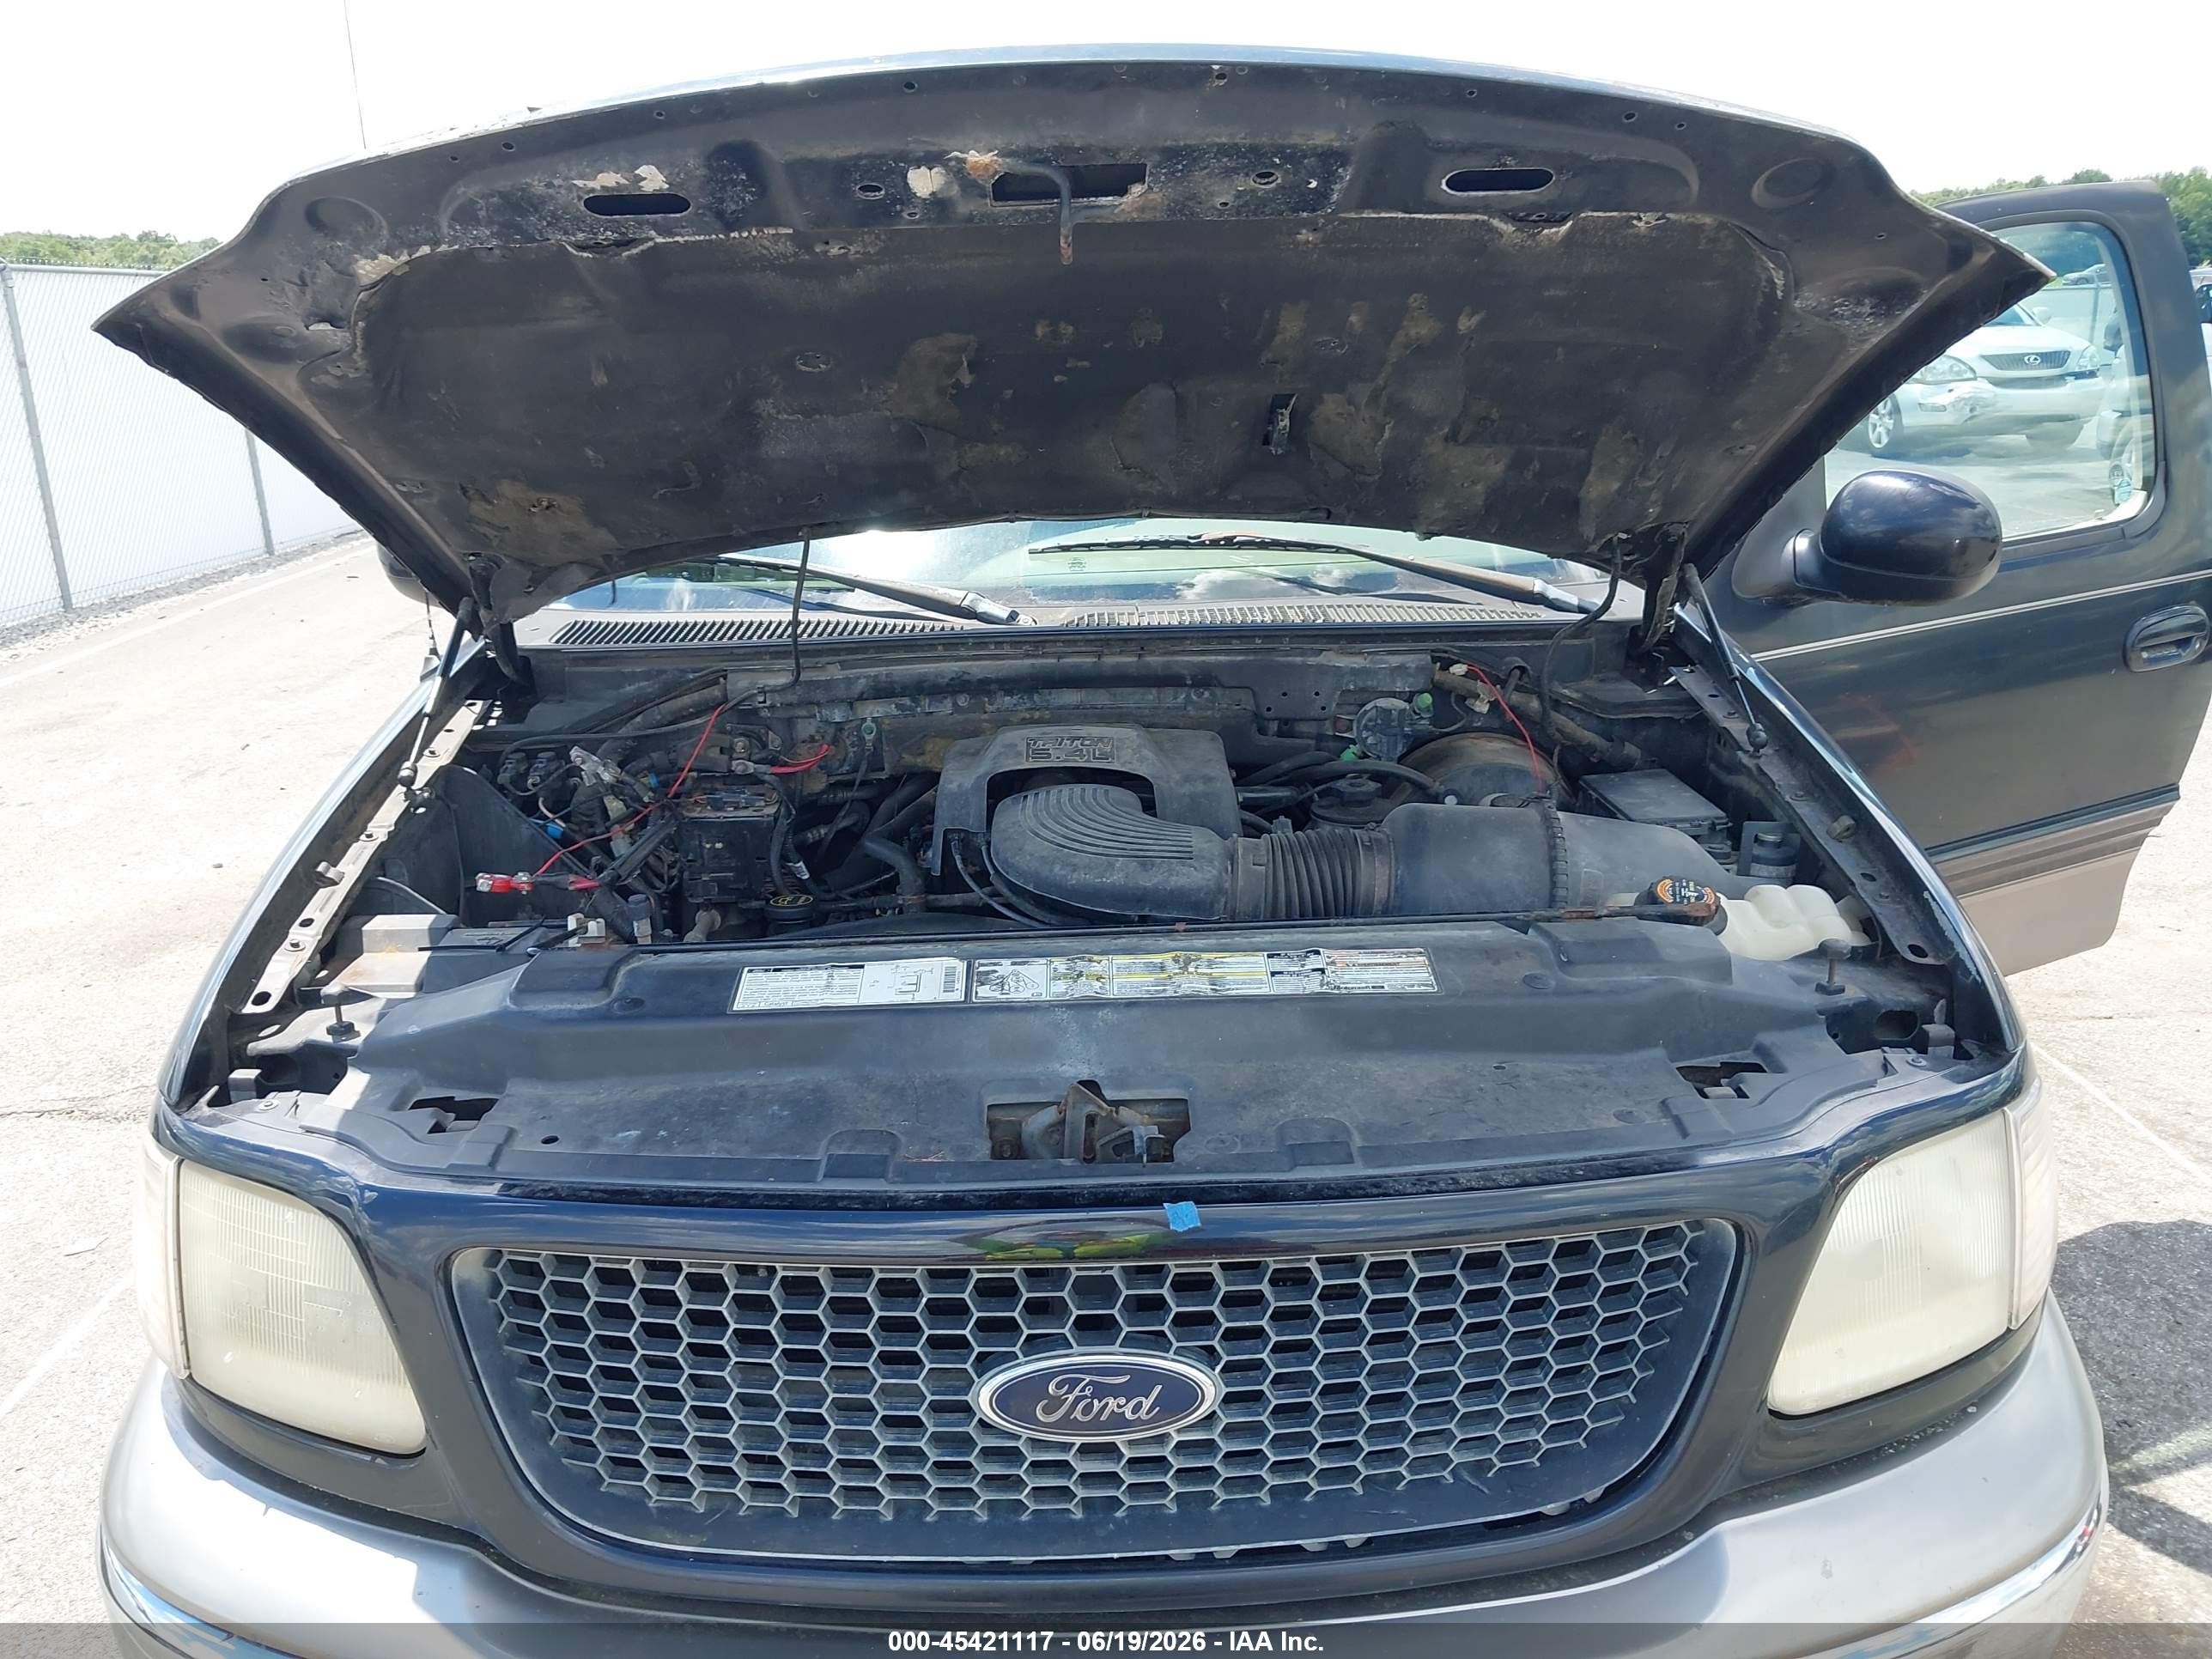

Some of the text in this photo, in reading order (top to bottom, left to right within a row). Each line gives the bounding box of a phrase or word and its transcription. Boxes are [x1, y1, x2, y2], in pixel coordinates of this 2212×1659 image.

[1027, 737, 1113, 749] TRITON
[1029, 748, 1111, 762] 5.4L
[1036, 1374, 1163, 1423] Ford
